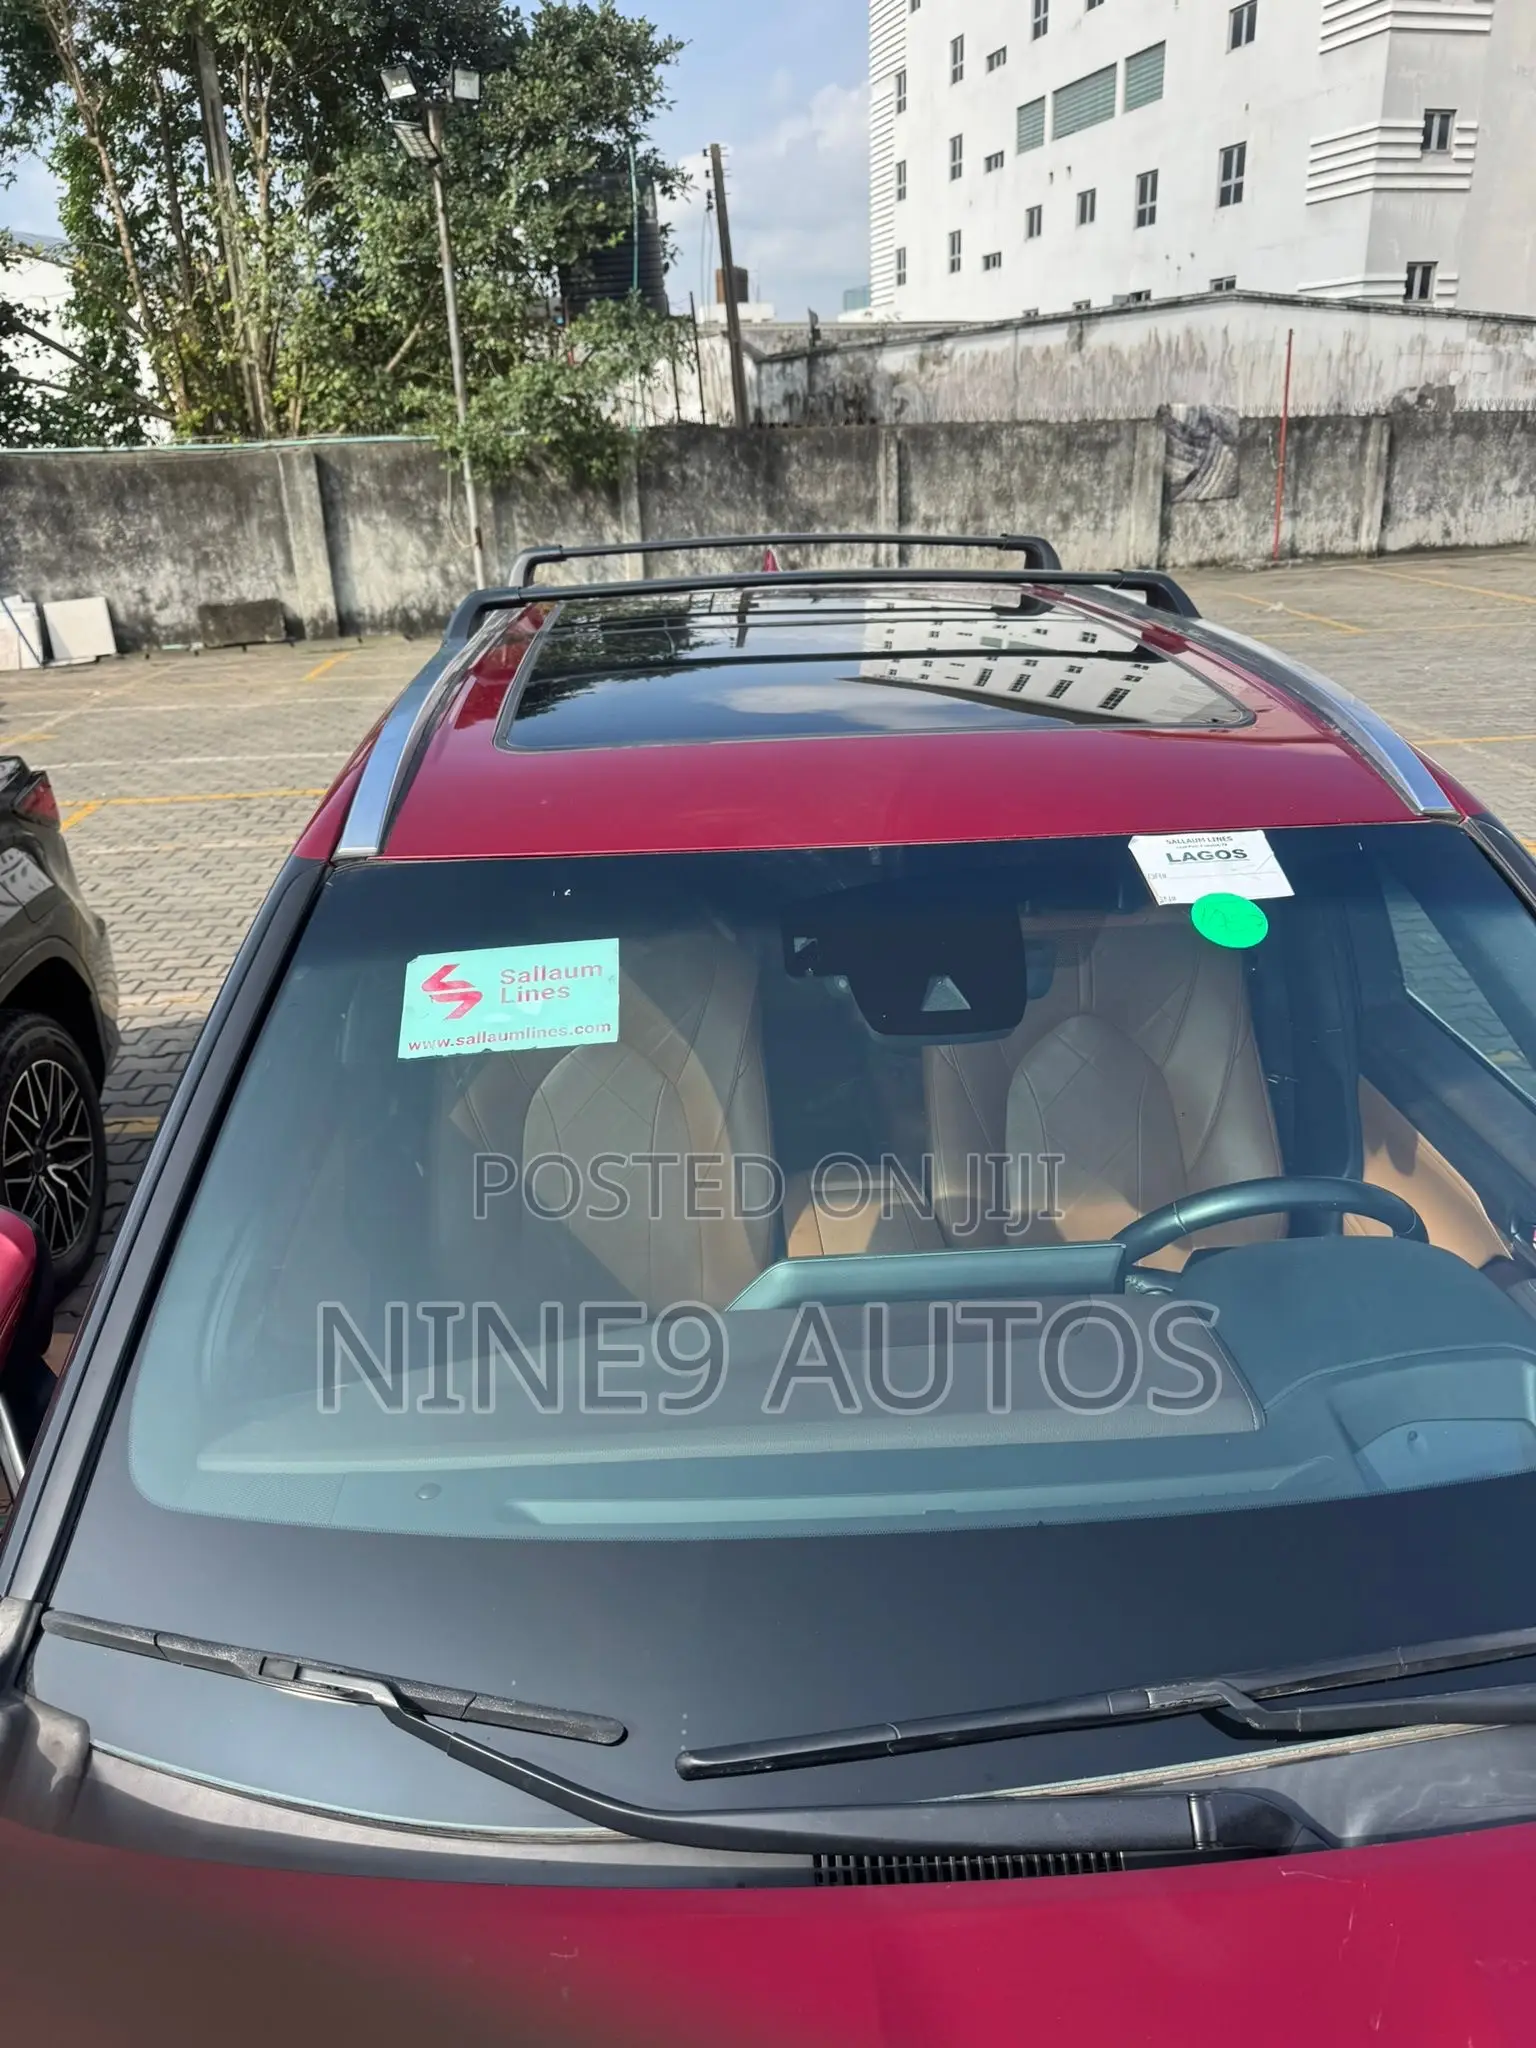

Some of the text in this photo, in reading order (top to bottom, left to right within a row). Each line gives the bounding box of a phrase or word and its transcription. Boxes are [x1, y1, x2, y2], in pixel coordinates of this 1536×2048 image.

[1166, 835, 1234, 845] SALLAUM LINES
[1165, 848, 1248, 863] LAGOS
[500, 964, 604, 985] Sallaum
[501, 985, 571, 1004] Lines
[408, 1022, 612, 1051] www.sallaumlines.com
